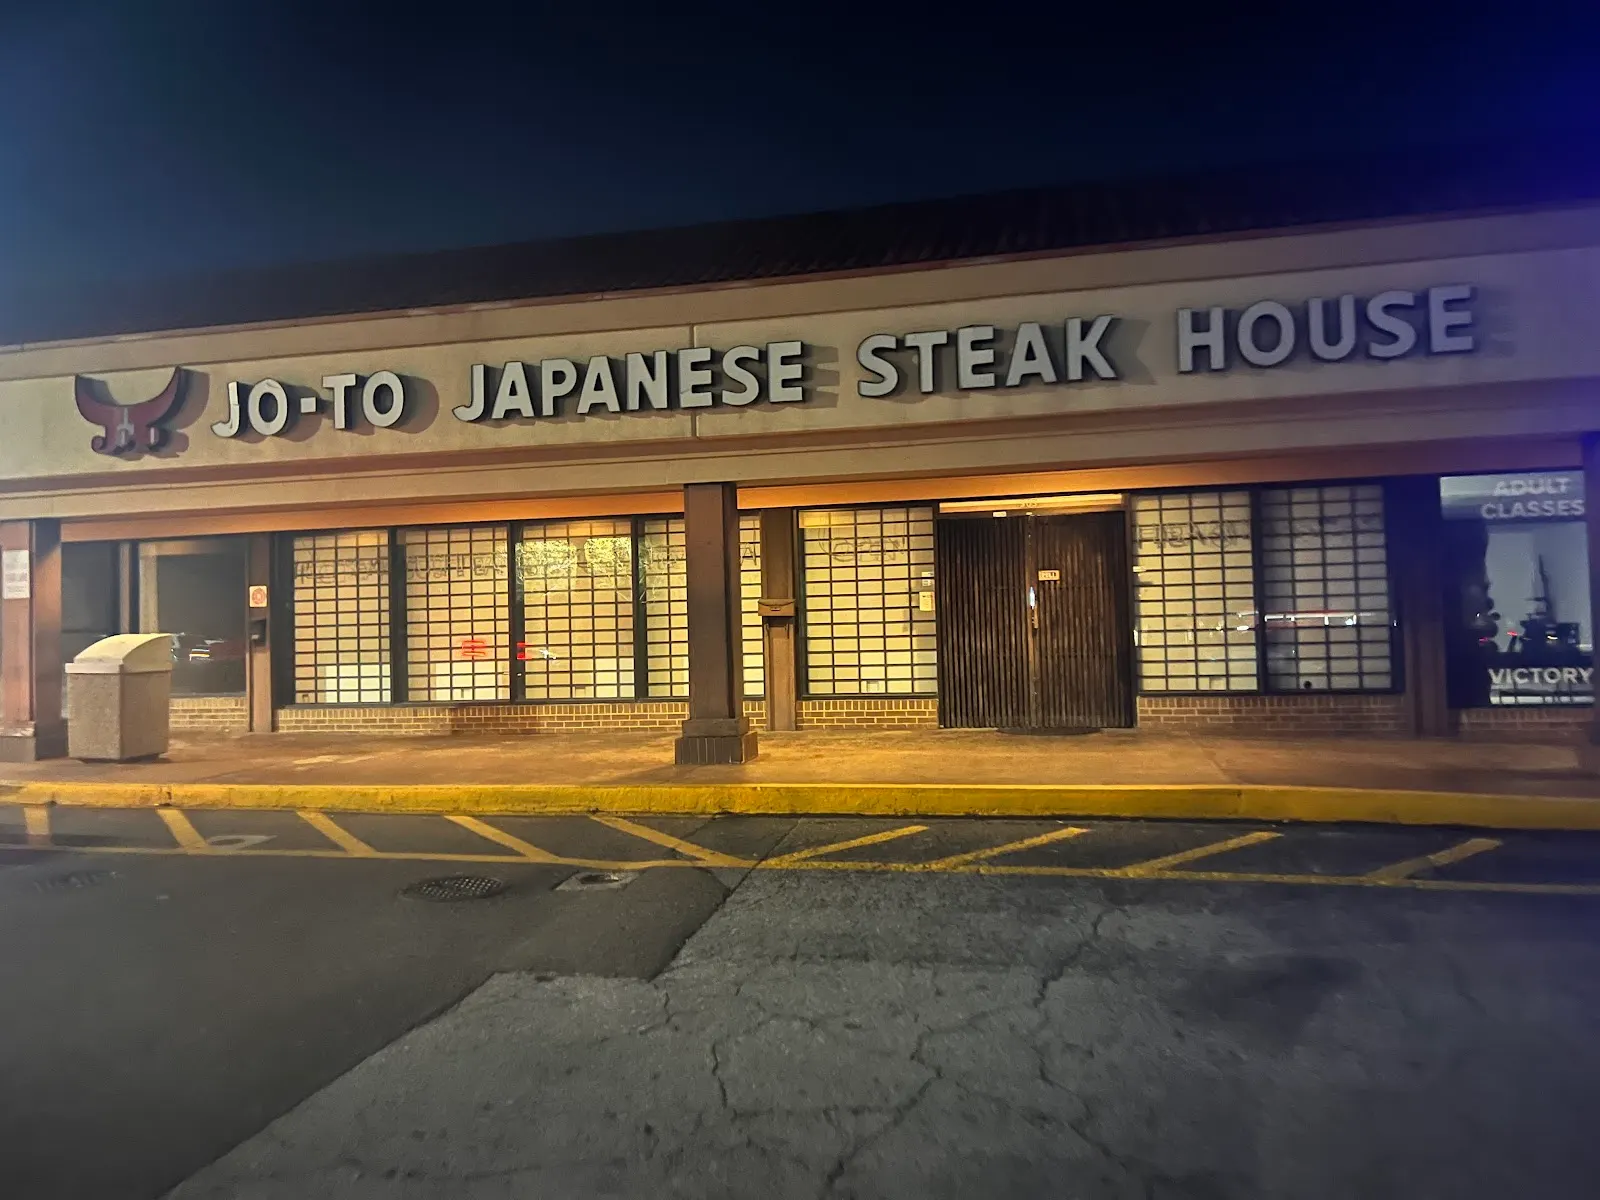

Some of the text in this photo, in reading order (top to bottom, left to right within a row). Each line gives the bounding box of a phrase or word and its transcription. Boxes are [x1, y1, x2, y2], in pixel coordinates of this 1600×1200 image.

[211, 283, 1475, 438] JO-TO JAPANESE STEAK HOUSE
[1492, 477, 1571, 497] ADULT
[1480, 498, 1586, 520] CLASSES
[1488, 667, 1594, 685] VICTORY
